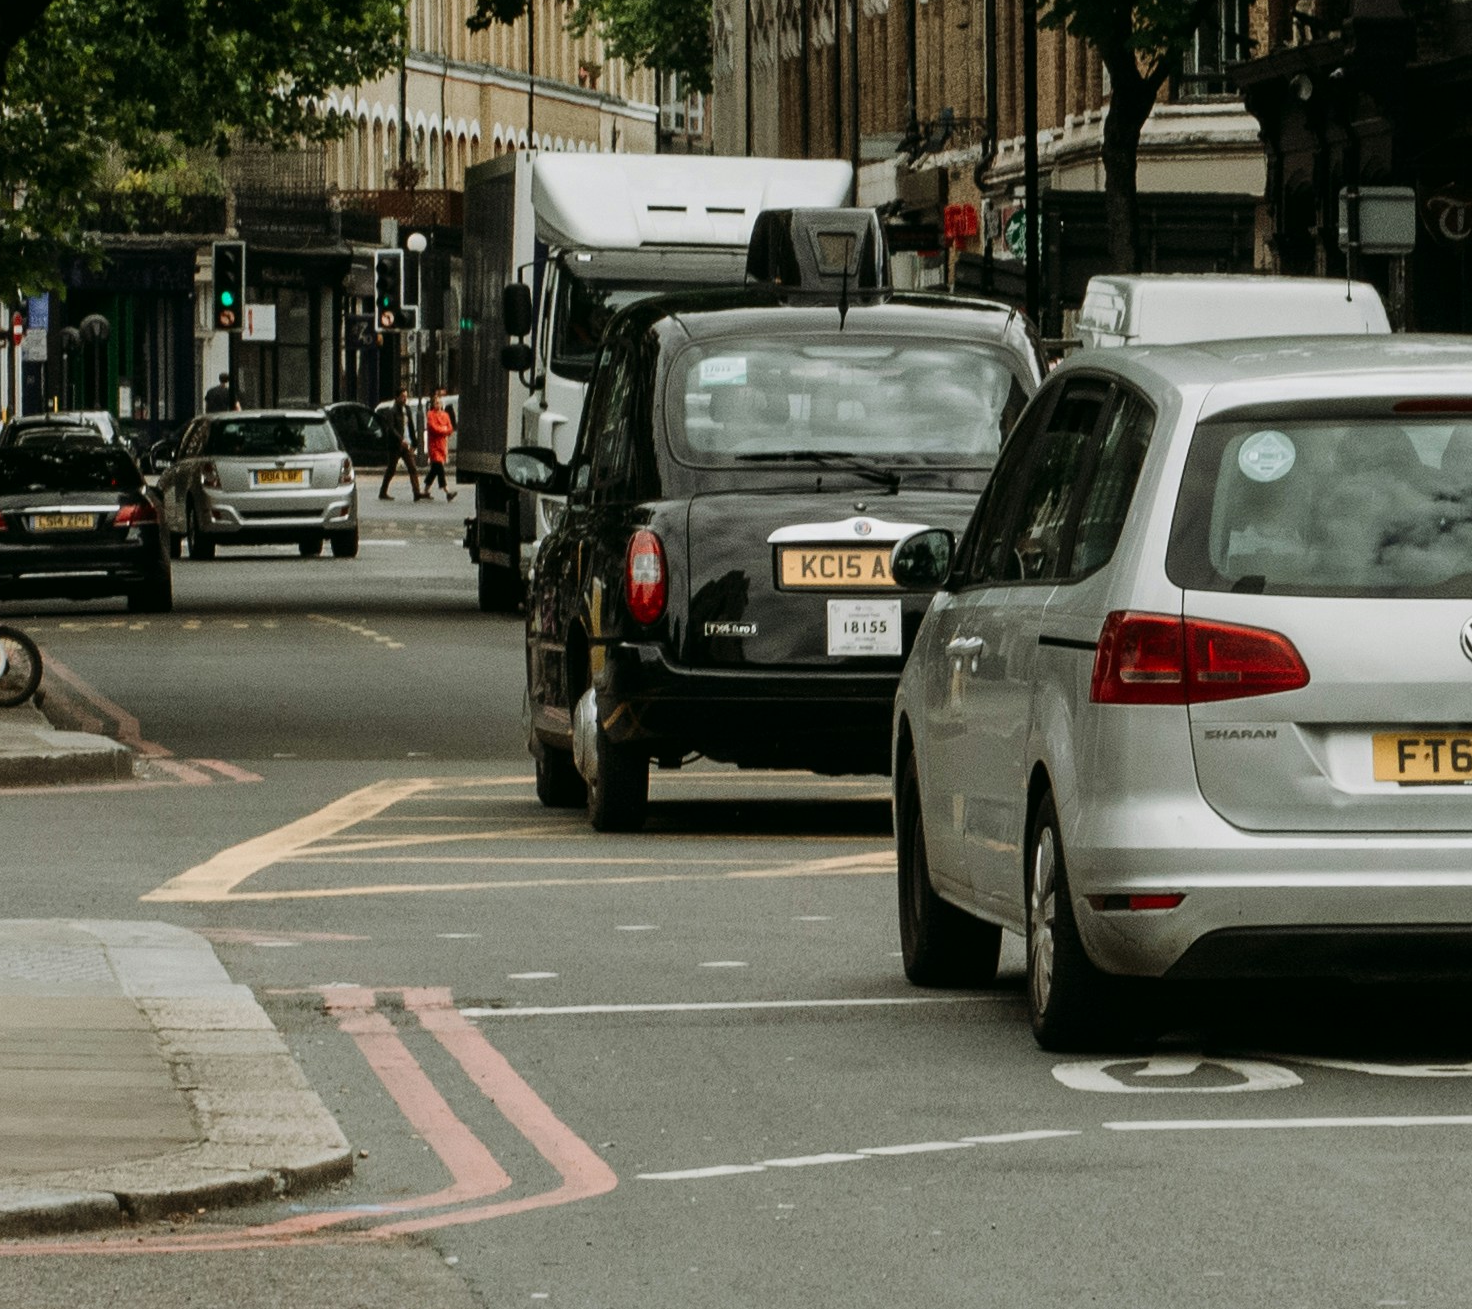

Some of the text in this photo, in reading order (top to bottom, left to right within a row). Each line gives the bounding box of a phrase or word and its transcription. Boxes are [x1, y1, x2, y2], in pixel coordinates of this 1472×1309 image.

[801, 554, 862, 579] KC15
[844, 621, 887, 634] 18155
[1203, 728, 1278, 741] SHARAN
